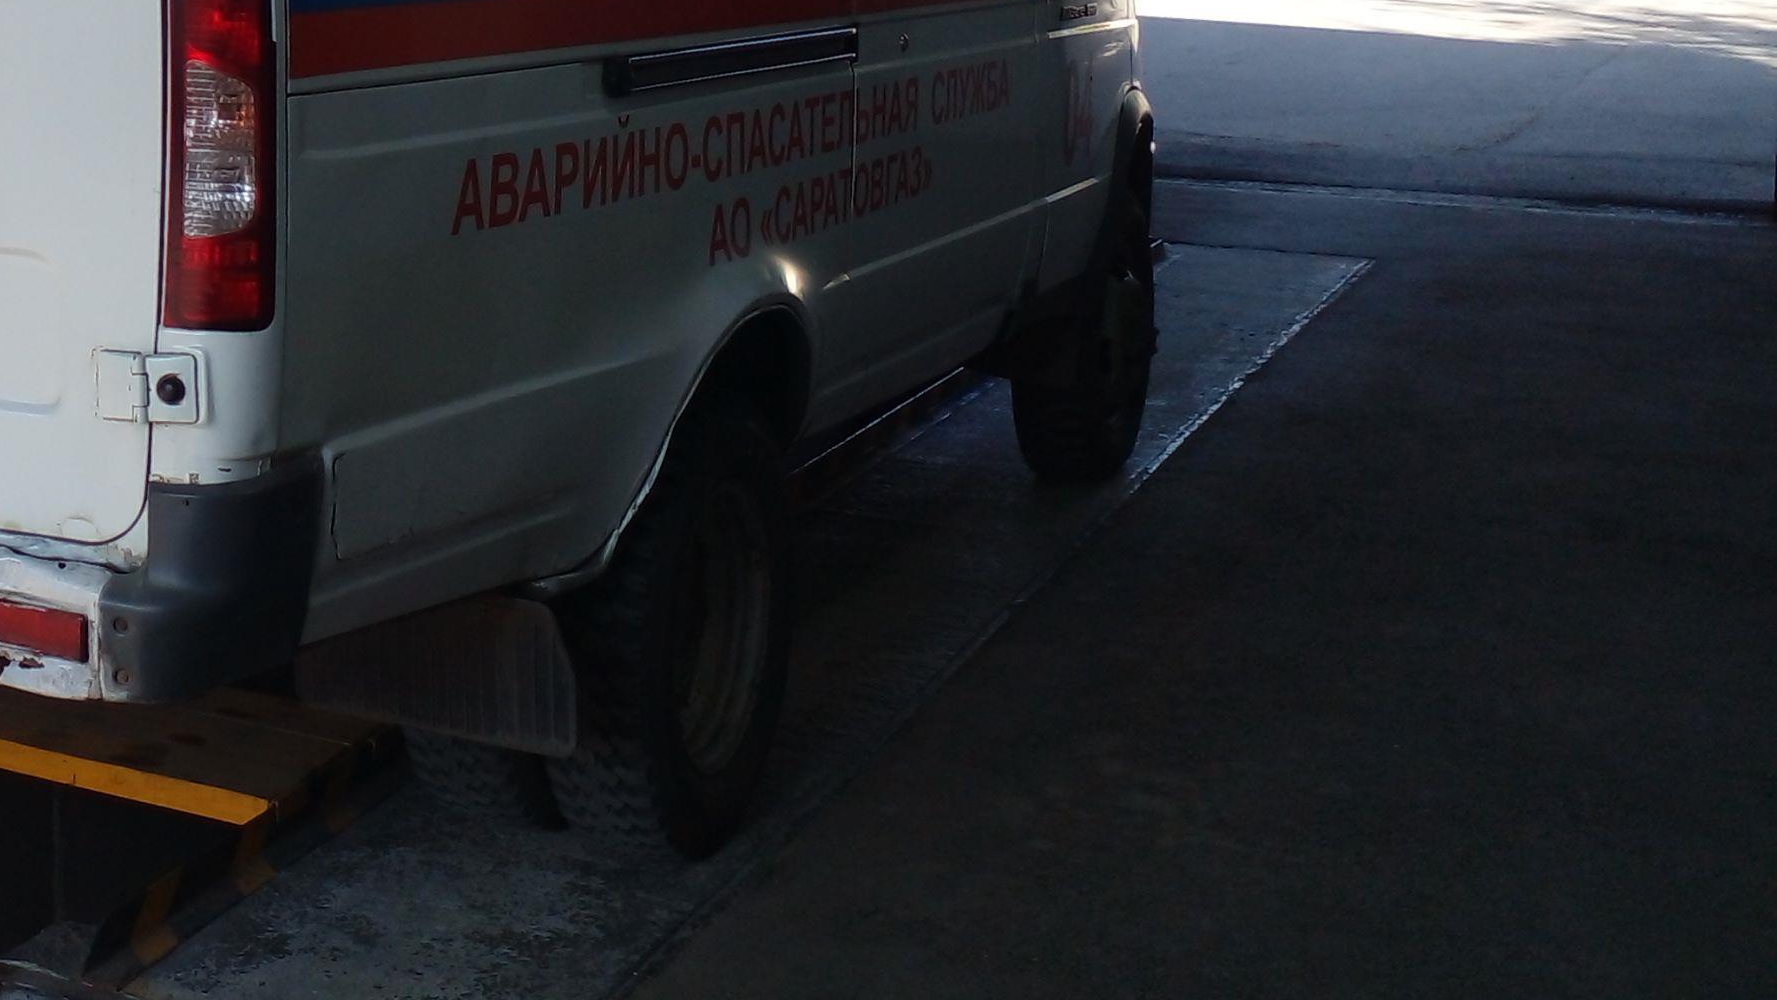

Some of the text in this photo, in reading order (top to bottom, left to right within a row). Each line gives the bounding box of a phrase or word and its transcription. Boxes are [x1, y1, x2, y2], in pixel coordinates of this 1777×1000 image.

[451, 57, 1011, 236] АВАРИЙНО-СПАСАТЕЛЬНАЯ СЛУЖБА
[708, 144, 934, 267] АО «САРАТОВГАЗ»
